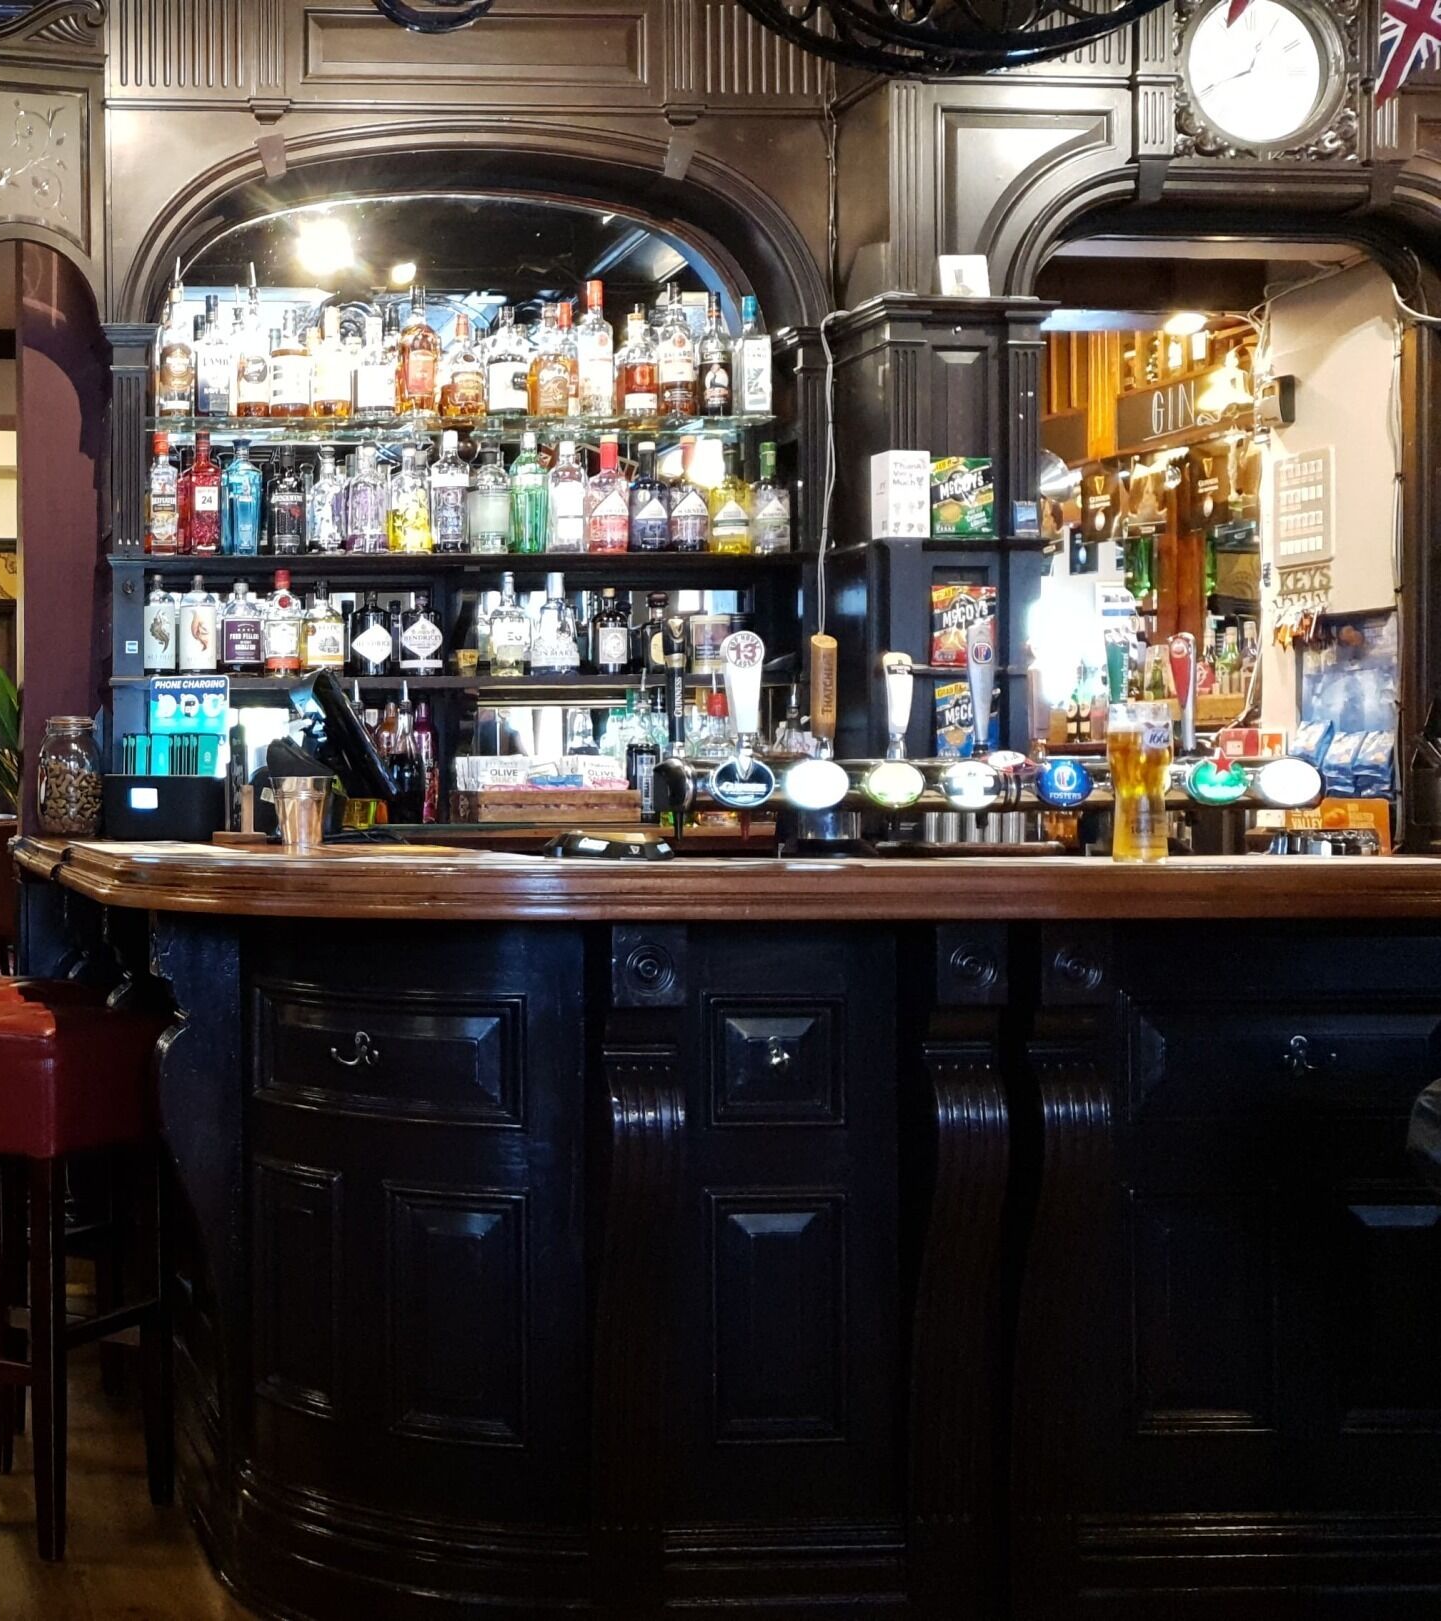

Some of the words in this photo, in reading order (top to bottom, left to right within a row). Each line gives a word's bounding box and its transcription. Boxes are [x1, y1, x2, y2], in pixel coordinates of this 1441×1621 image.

[1152, 380, 1196, 435] GIN
[201, 496, 213, 505] 24
[1278, 564, 1333, 596] KEYS
[735, 643, 757, 660] 13
[154, 680, 181, 689] PHONE
[182, 679, 225, 689] CHARGING
[674, 676, 683, 717] GUINNESS
[490, 768, 519, 777] OLIVE
[588, 768, 616, 778] OLIVE
[1291, 817, 1323, 829] VALLEY
